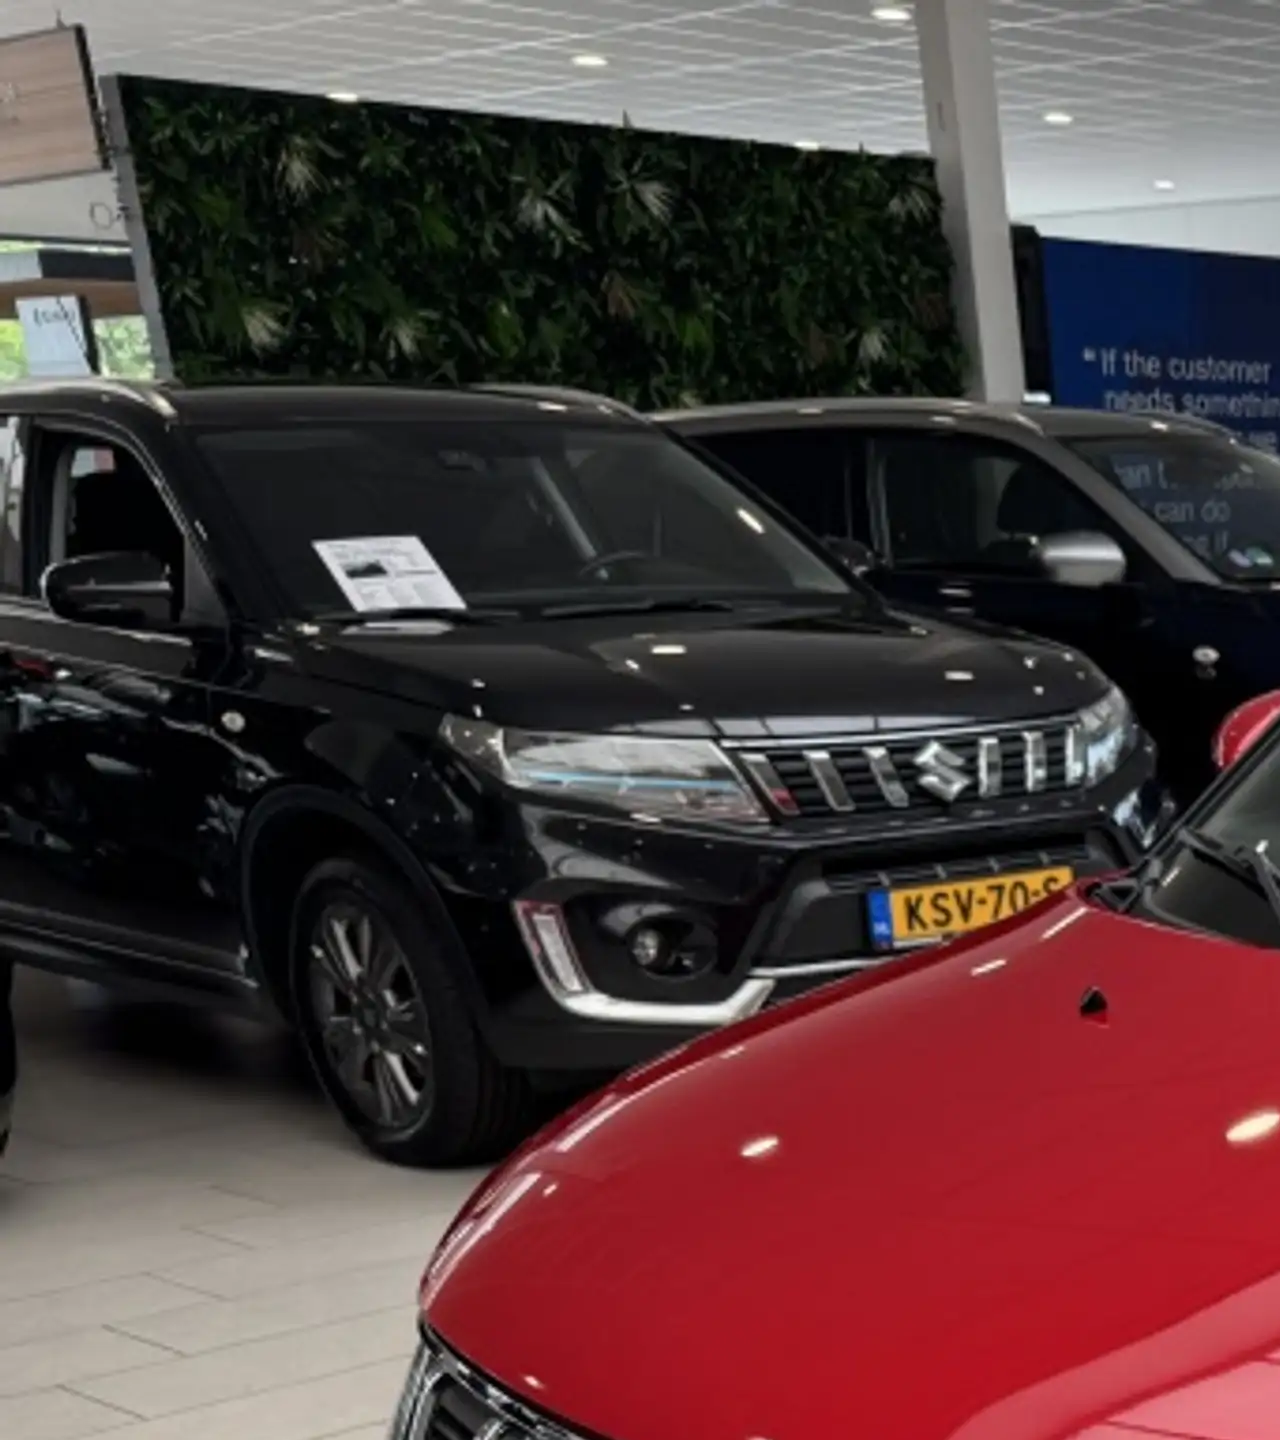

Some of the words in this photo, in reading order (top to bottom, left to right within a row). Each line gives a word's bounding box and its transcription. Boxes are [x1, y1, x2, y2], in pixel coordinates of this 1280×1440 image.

[1123, 349, 1162, 379] the
[1167, 354, 1272, 385] customer
[1104, 387, 1176, 413] needs
